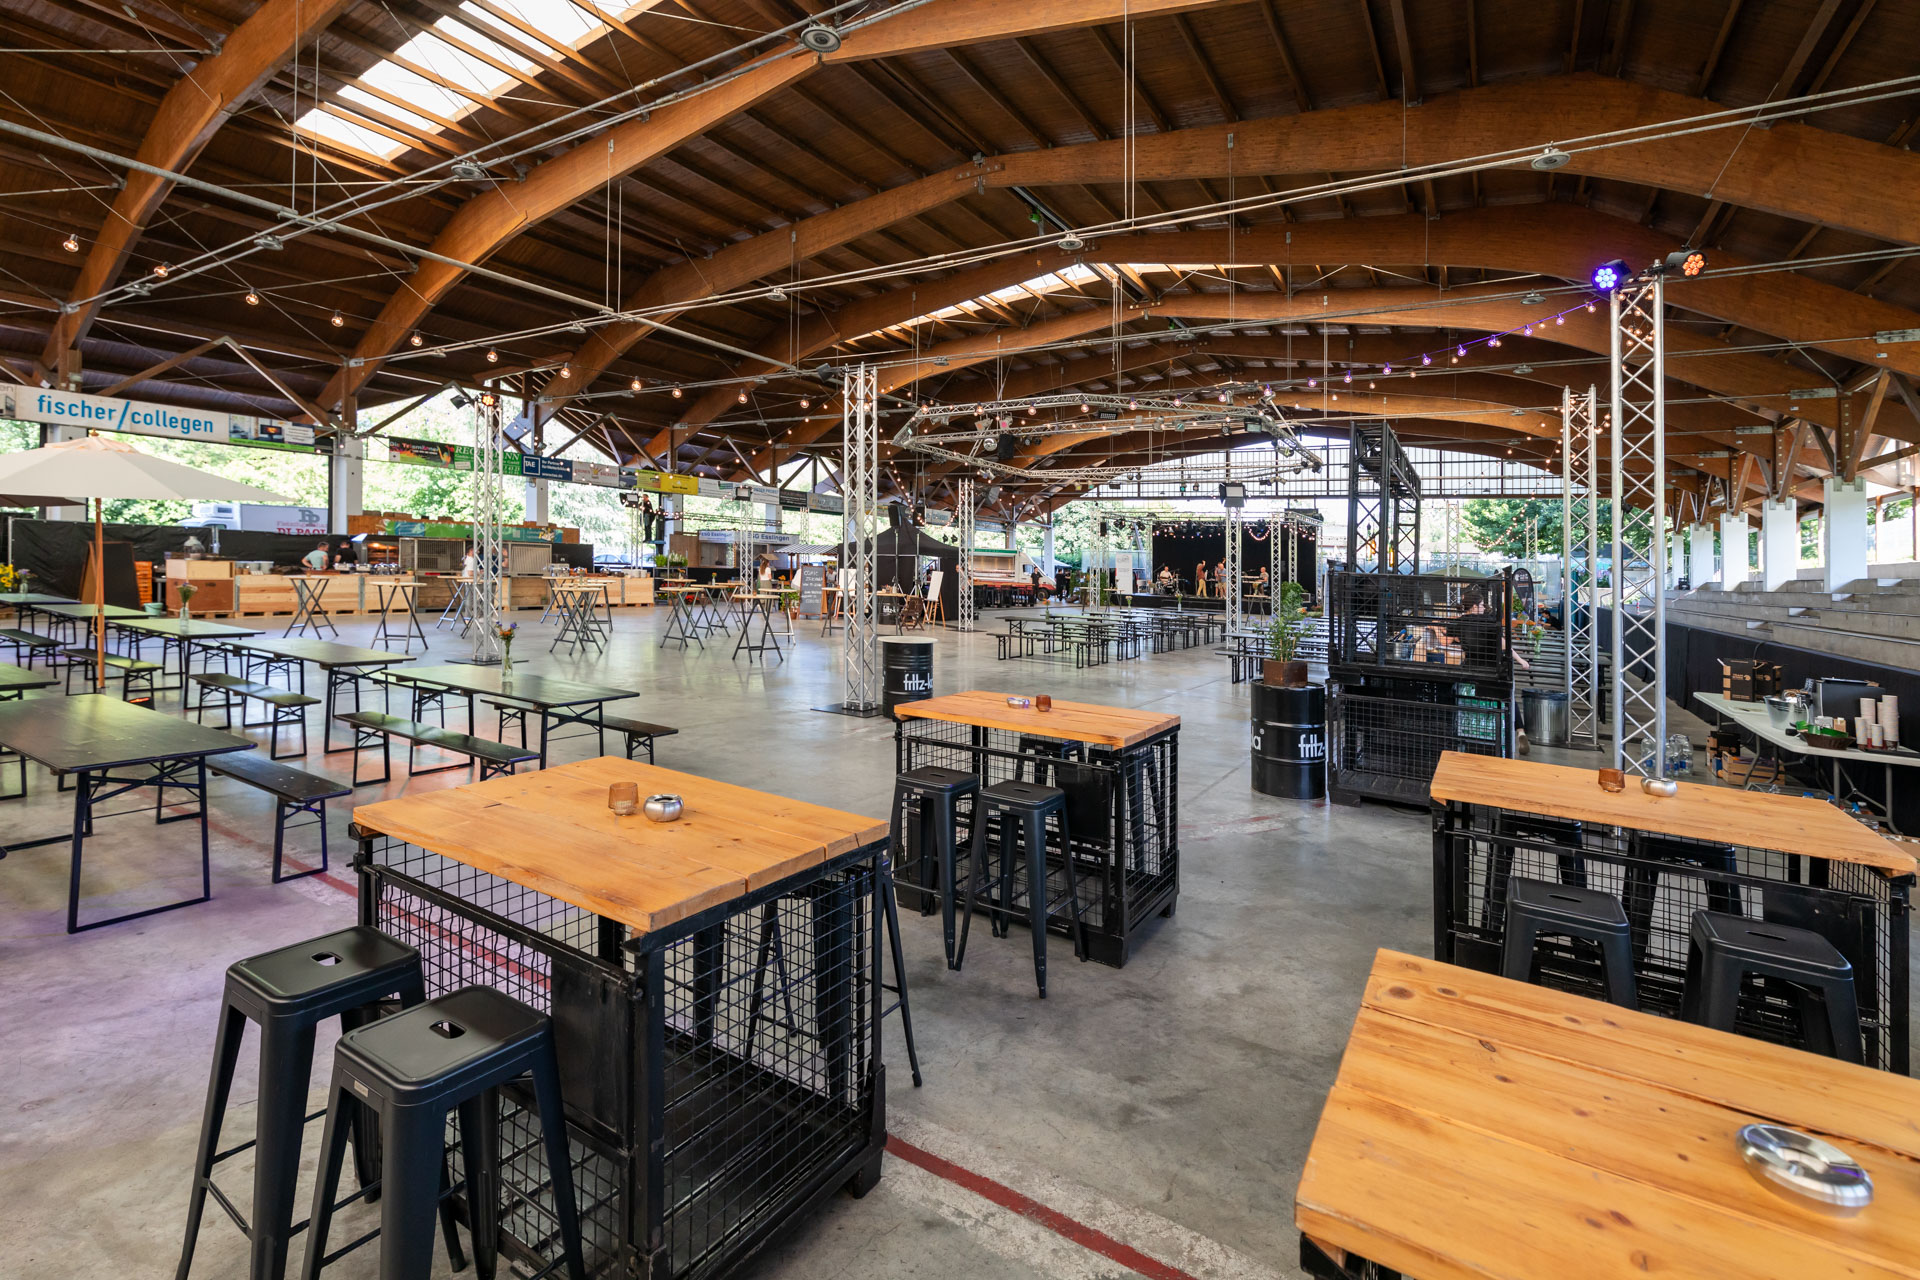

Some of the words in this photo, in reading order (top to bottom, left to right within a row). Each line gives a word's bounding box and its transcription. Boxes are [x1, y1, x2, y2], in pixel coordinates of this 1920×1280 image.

[37, 394, 214, 435] fischer/collegen
[525, 460, 536, 468] TAE
[761, 533, 790, 542] Esslingen
